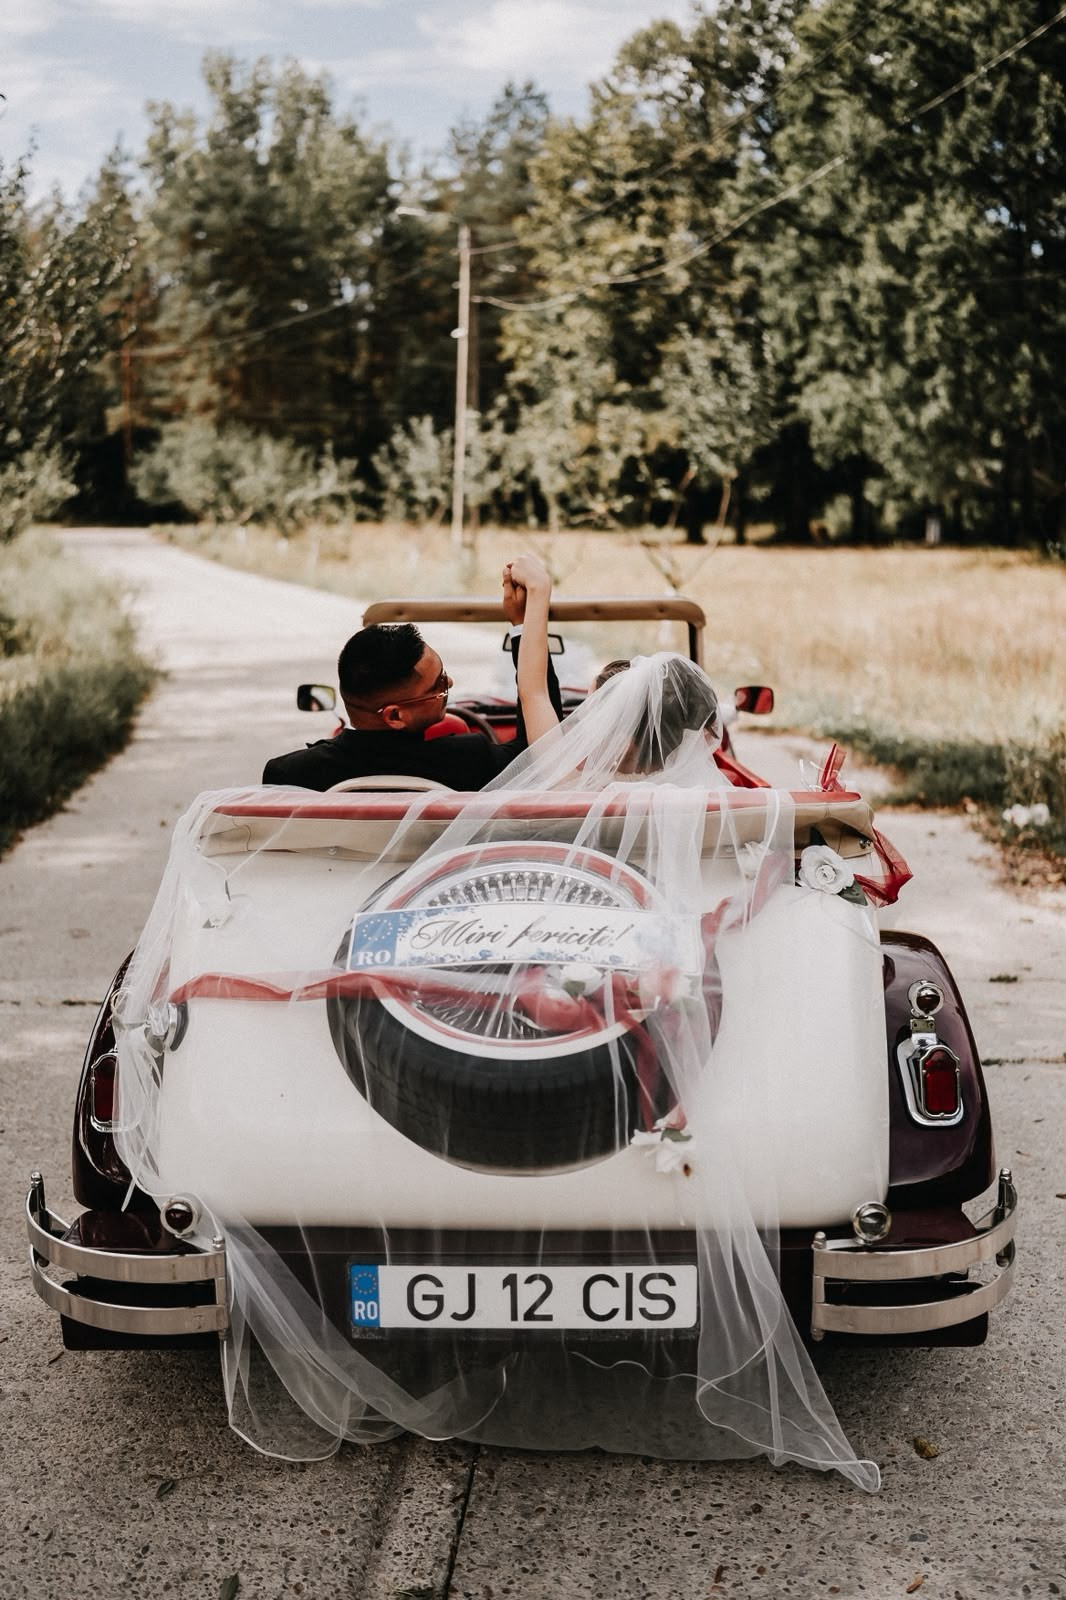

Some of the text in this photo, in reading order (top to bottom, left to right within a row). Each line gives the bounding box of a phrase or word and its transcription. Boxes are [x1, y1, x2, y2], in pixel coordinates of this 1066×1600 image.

[410, 917, 509, 950] Miri
[355, 949, 392, 967] RO
[353, 1300, 378, 1320] RO
[406, 1272, 677, 1322] GJ 12 CIS
